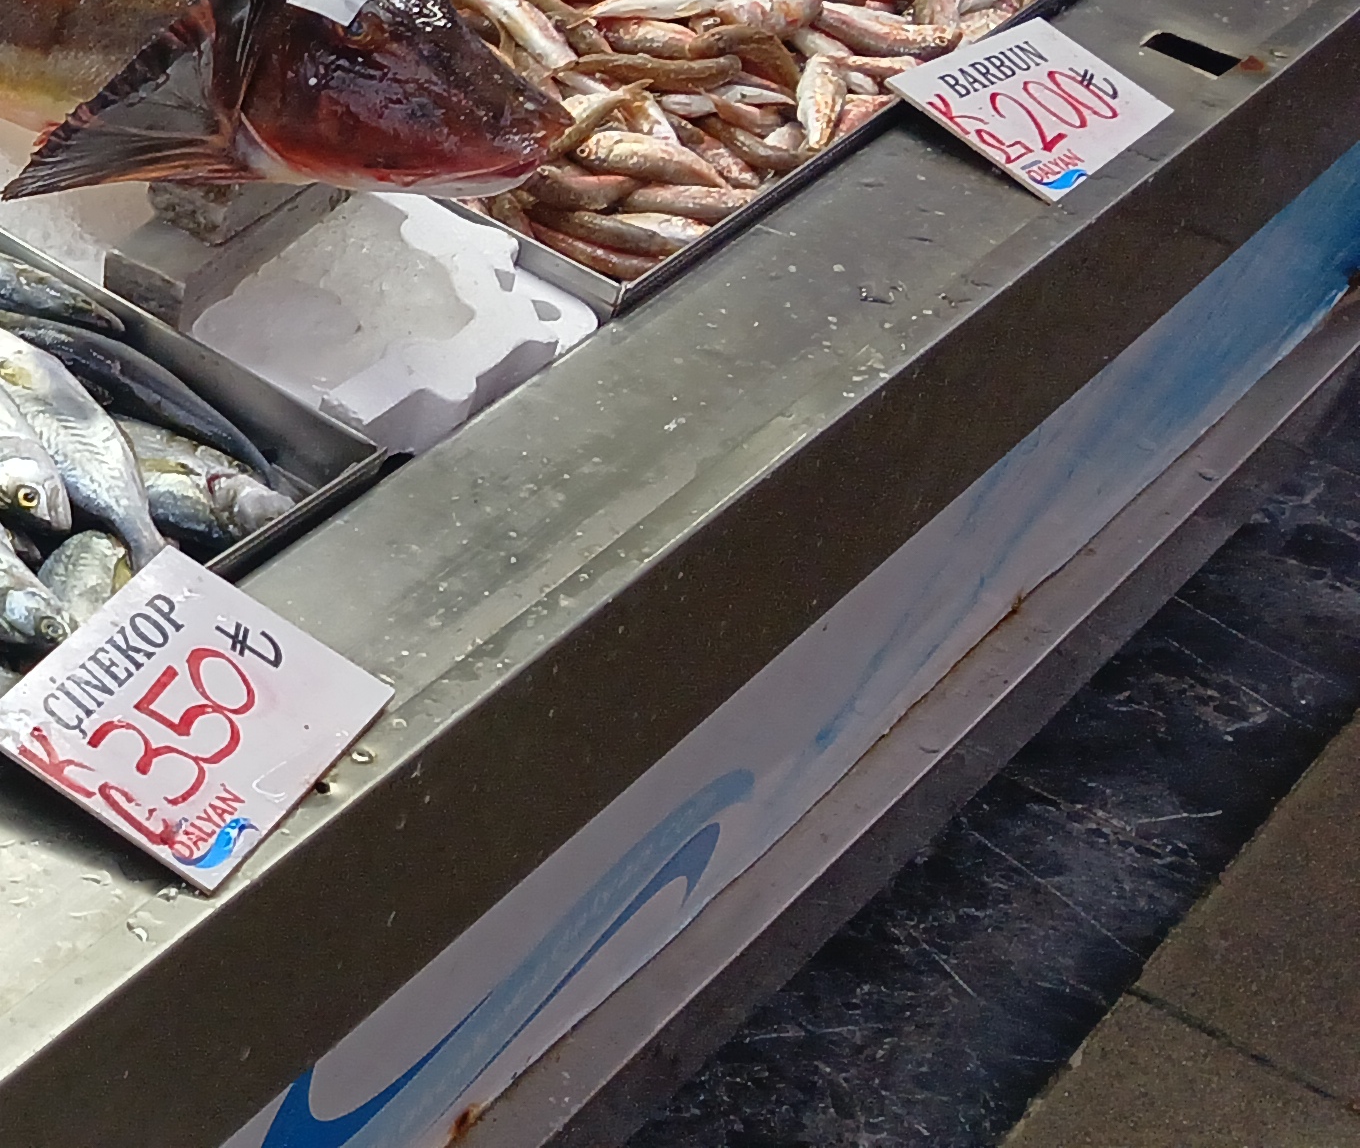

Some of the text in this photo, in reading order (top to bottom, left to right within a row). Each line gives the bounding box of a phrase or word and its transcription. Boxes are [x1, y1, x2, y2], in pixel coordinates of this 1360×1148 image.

[939, 41, 1049, 99] BARBUN
[1025, 148, 1086, 184] DALYAN
[42, 593, 185, 740] ÇİNEKOP
[173, 782, 246, 862] DALYAN
